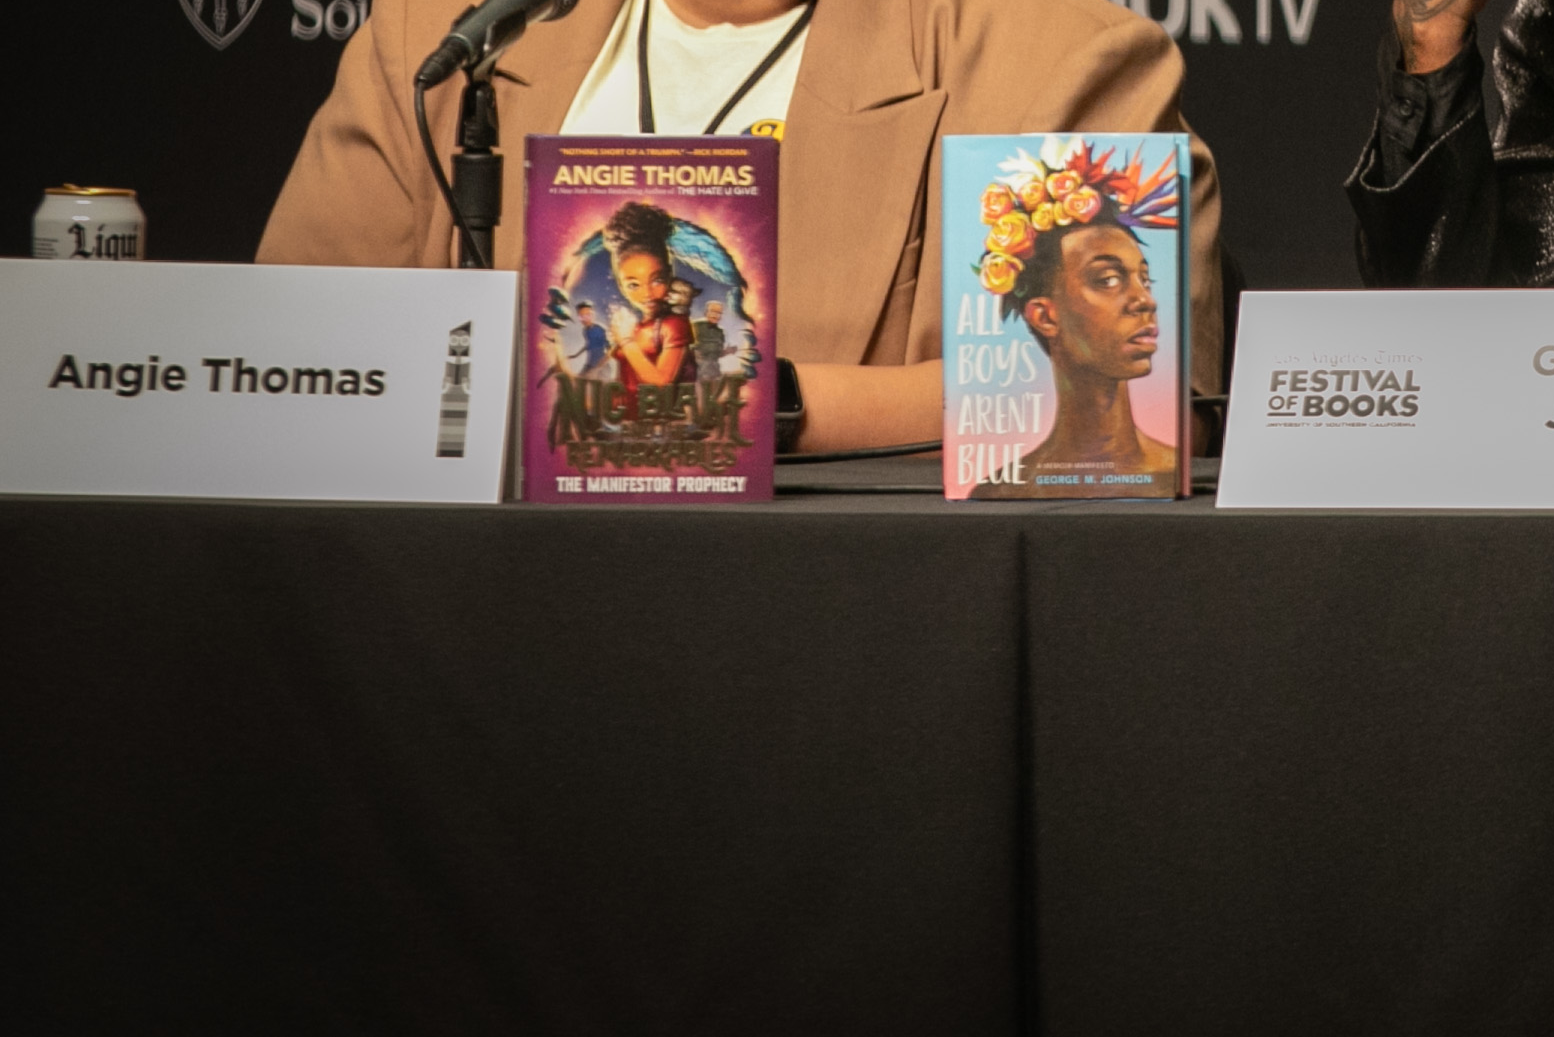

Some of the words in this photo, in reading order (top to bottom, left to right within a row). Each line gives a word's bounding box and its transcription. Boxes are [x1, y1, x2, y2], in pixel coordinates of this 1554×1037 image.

[552, 164, 637, 186] ANGIE
[641, 164, 756, 187] THOMAS
[677, 186, 696, 195] THE
[697, 186, 723, 195] HATE
[733, 186, 758, 196] GIVE
[956, 292, 1005, 336] ALL
[47, 353, 187, 397] Angie
[201, 356, 387, 397] Thomas
[957, 339, 1037, 388] BOYS
[1269, 369, 1421, 392] FESTIVAL
[957, 392, 1045, 436] AREN'T
[1267, 395, 1299, 411] OF
[1301, 394, 1420, 418] BOOKS
[957, 443, 1029, 487] BLUE
[556, 476, 583, 493] THE
[586, 476, 673, 493] MANIFESTOR
[676, 476, 747, 493] PROPHECY
[1035, 474, 1080, 485] GEORGE
[1099, 474, 1153, 485] JOHNSON
